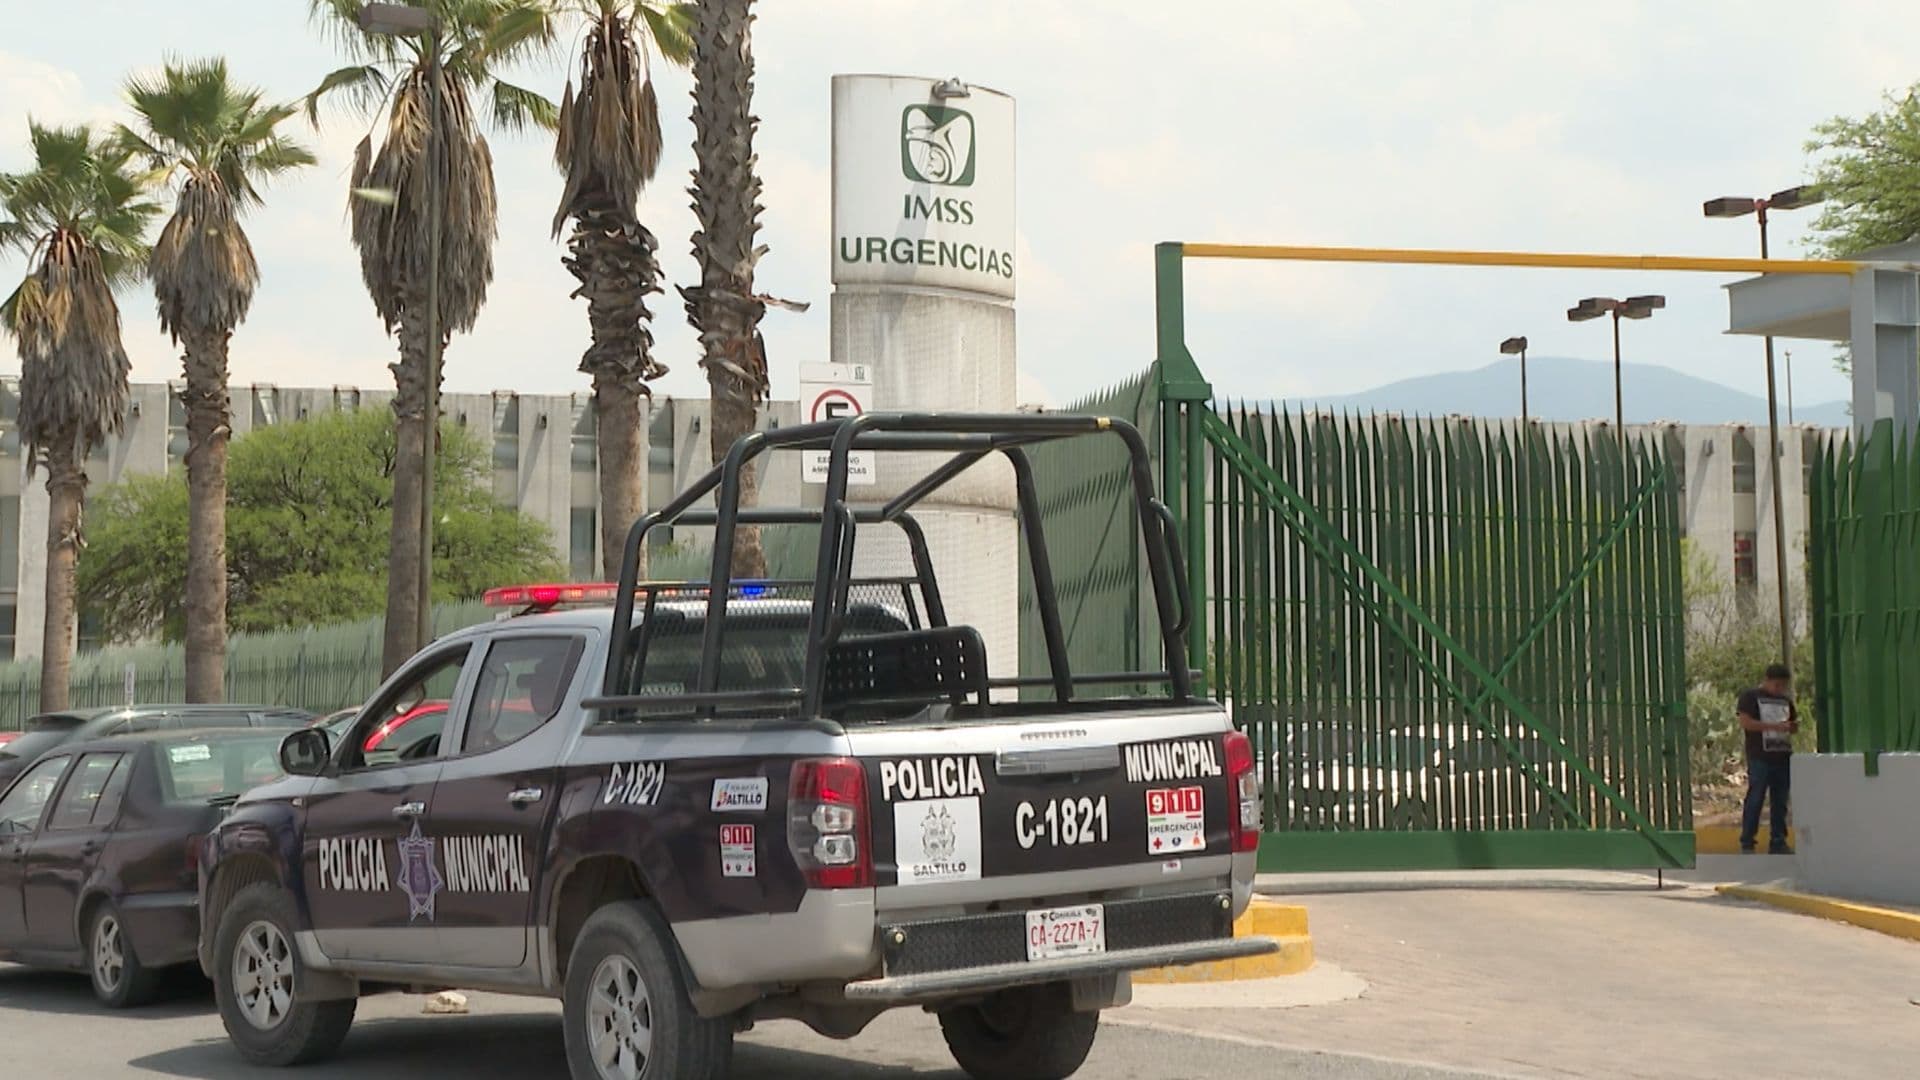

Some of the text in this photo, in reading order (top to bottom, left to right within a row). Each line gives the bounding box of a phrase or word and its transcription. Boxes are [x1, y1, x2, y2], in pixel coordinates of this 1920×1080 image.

[903, 194, 974, 224] IMSS
[841, 237, 1013, 278] URGENCIAS
[604, 761, 665, 805] C-1821
[880, 740, 1222, 801] POLICIA MUNICIPAL
[1151, 791, 1197, 813] 911
[723, 827, 751, 843] 911
[1015, 796, 1109, 849] C-1821
[1149, 822, 1202, 833] EMERGENCIAS
[319, 835, 530, 892] POLICIA MUNICIPAL
[913, 862, 966, 876] SALTILLO
[1031, 920, 1099, 946] CA-227A-7
